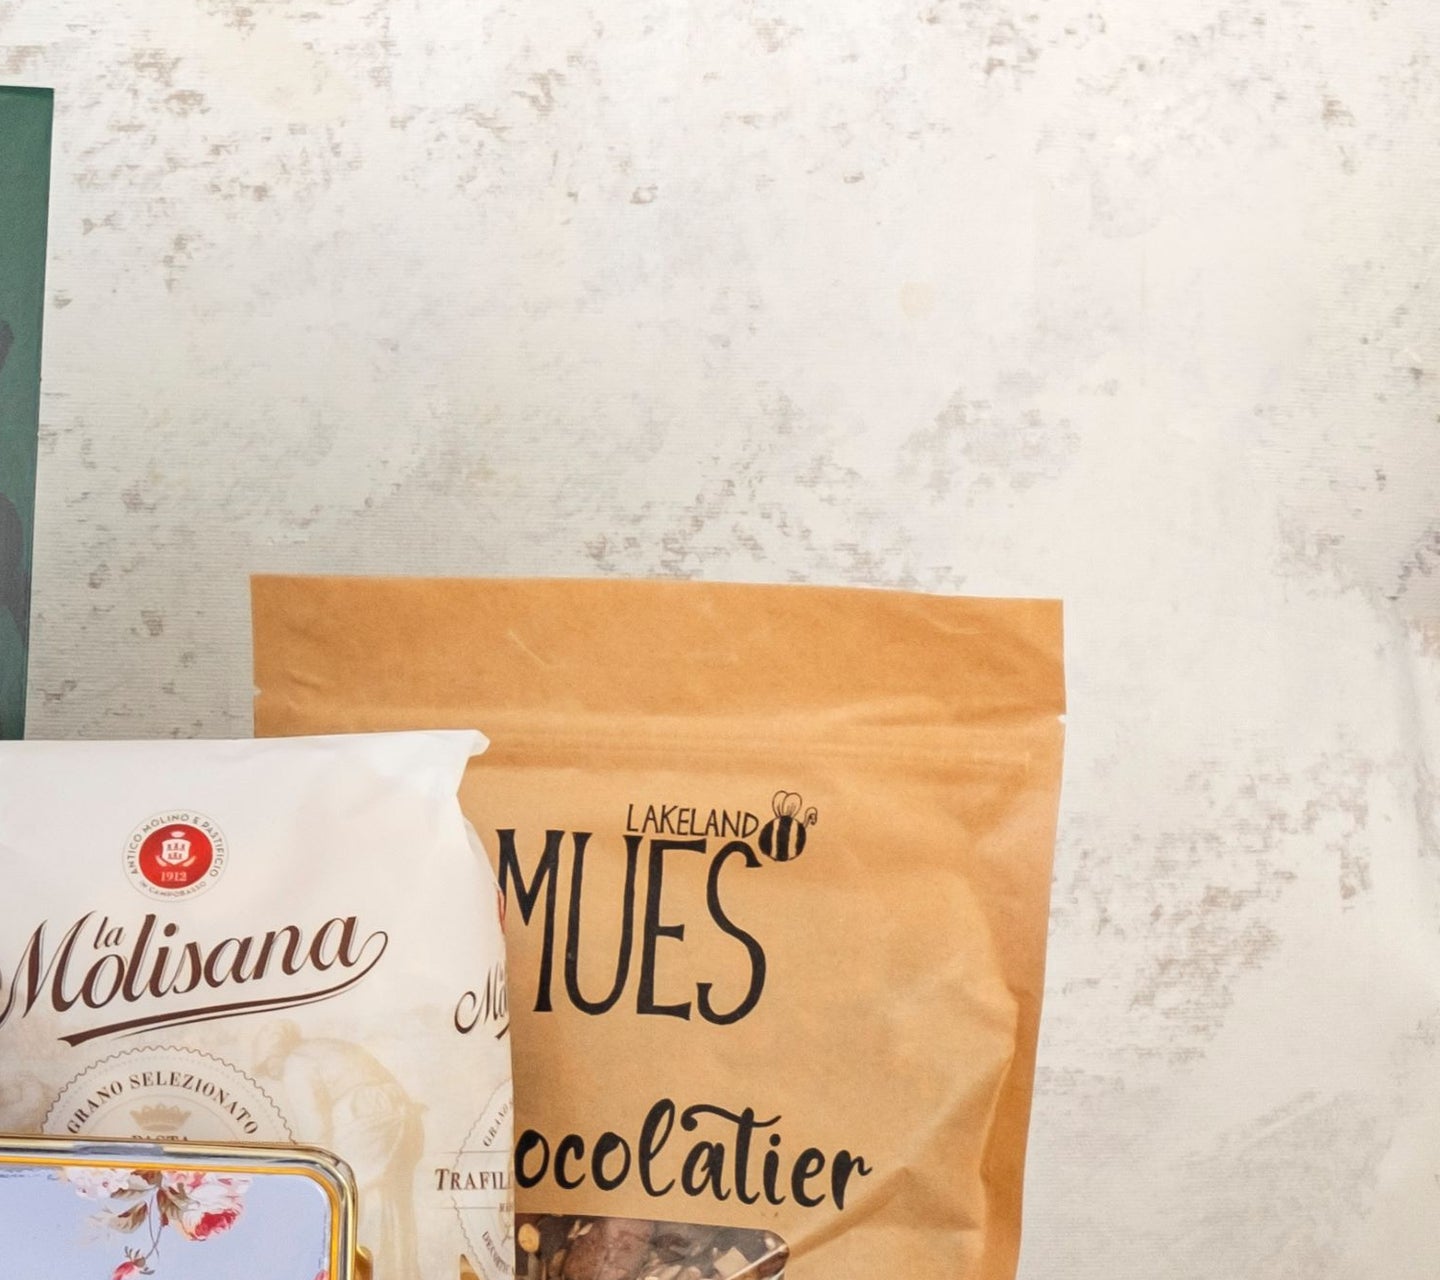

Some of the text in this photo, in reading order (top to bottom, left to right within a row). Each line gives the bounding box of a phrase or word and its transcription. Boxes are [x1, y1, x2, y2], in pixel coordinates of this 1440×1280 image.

[127, 813, 224, 877] ANTICO MOLINO PASTIFICIO
[626, 803, 759, 838] LAKELAND
[161, 871, 187, 882] 1912
[93, 916, 126, 950] la
[496, 827, 767, 1025] MUES
[67, 1071, 259, 1136] GRANO SELEZIONATO
[514, 1097, 872, 1210] ocolatier
